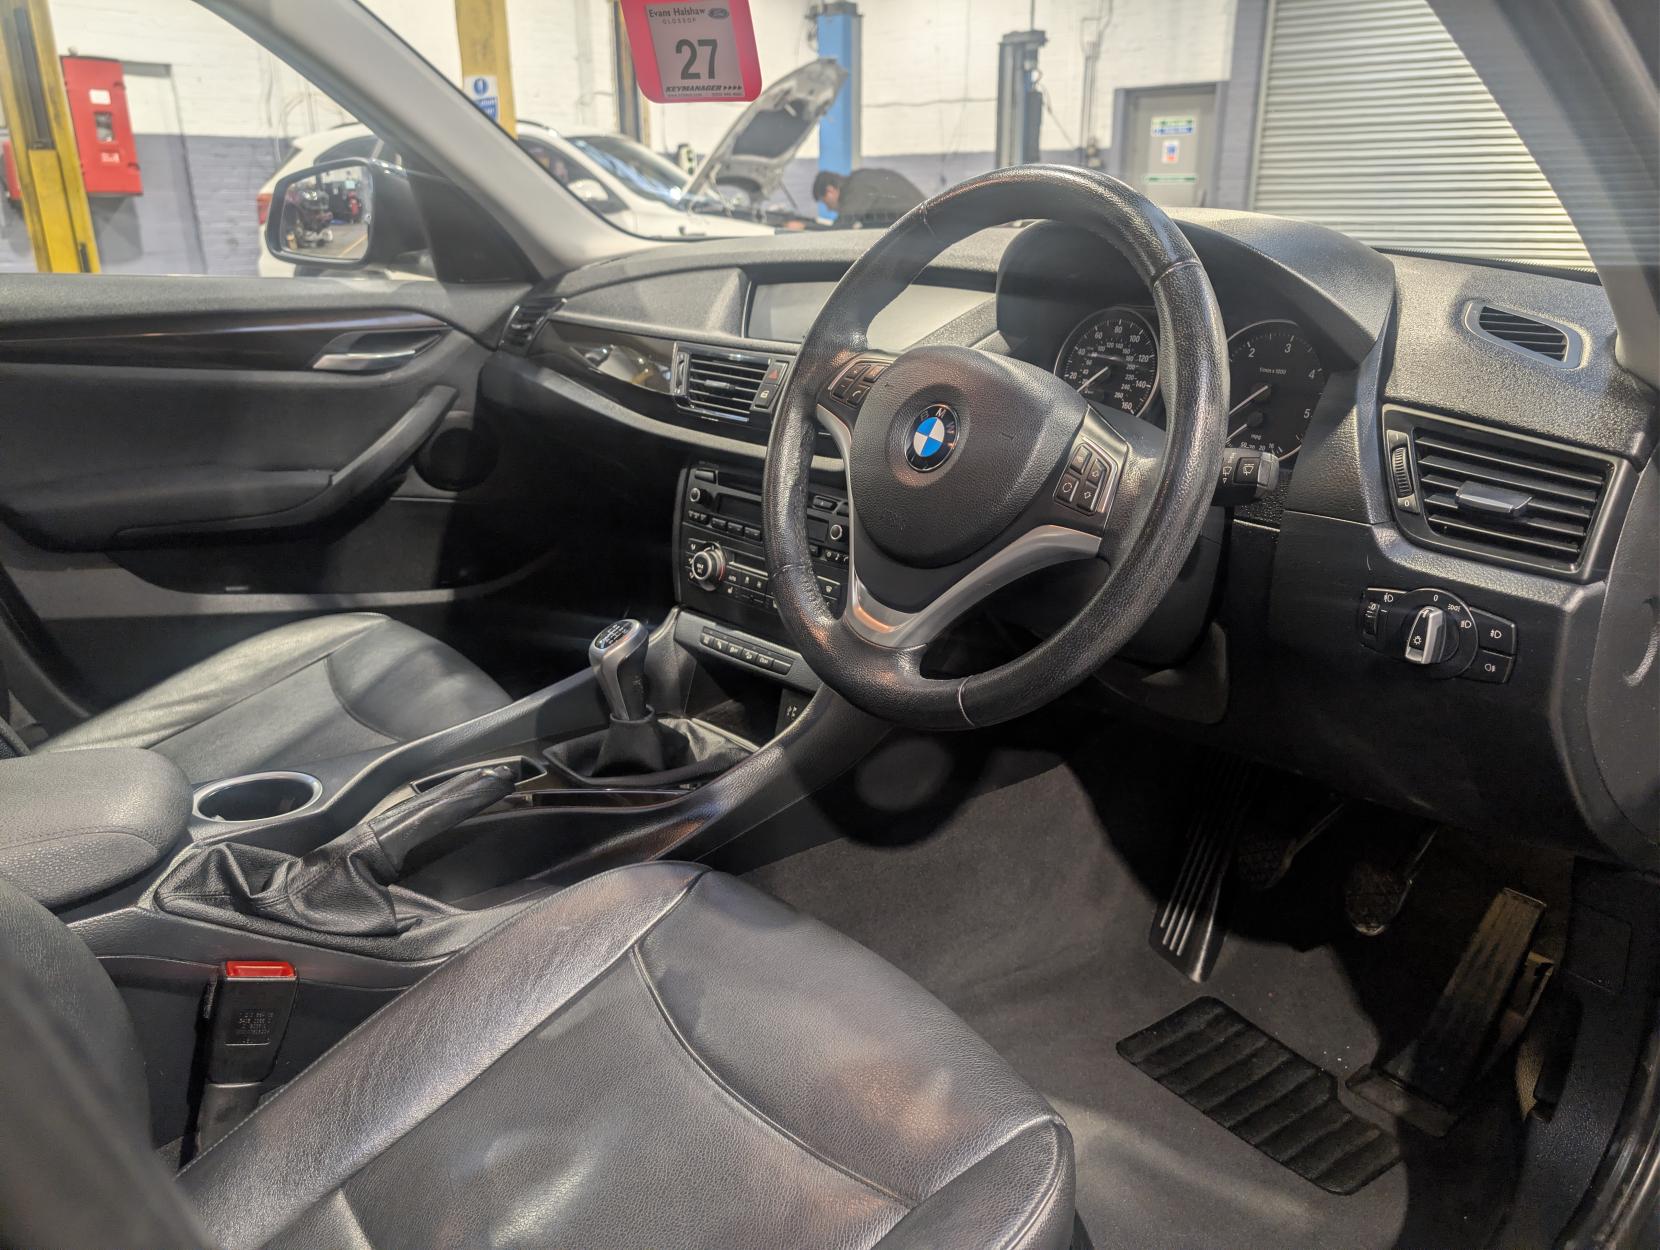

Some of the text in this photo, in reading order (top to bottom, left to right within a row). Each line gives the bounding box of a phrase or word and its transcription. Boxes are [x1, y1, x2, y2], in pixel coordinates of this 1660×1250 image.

[648, 8, 671, 18] Evans
[673, 7, 706, 16] Halshaw
[675, 38, 718, 80] 27
[665, 84, 722, 92] KEYMANAGER
[1129, 335, 1140, 343] 100
[1284, 343, 1292, 353] 3
[1248, 348, 1256, 358] 2
[1138, 355, 1149, 363] 120
[1069, 371, 1078, 380] 20
[1308, 369, 1316, 380] 4
[1121, 383, 1131, 391] 240
[1135, 381, 1147, 389] 140
[1121, 401, 1133, 410] 160
[1303, 408, 1311, 419] 5
